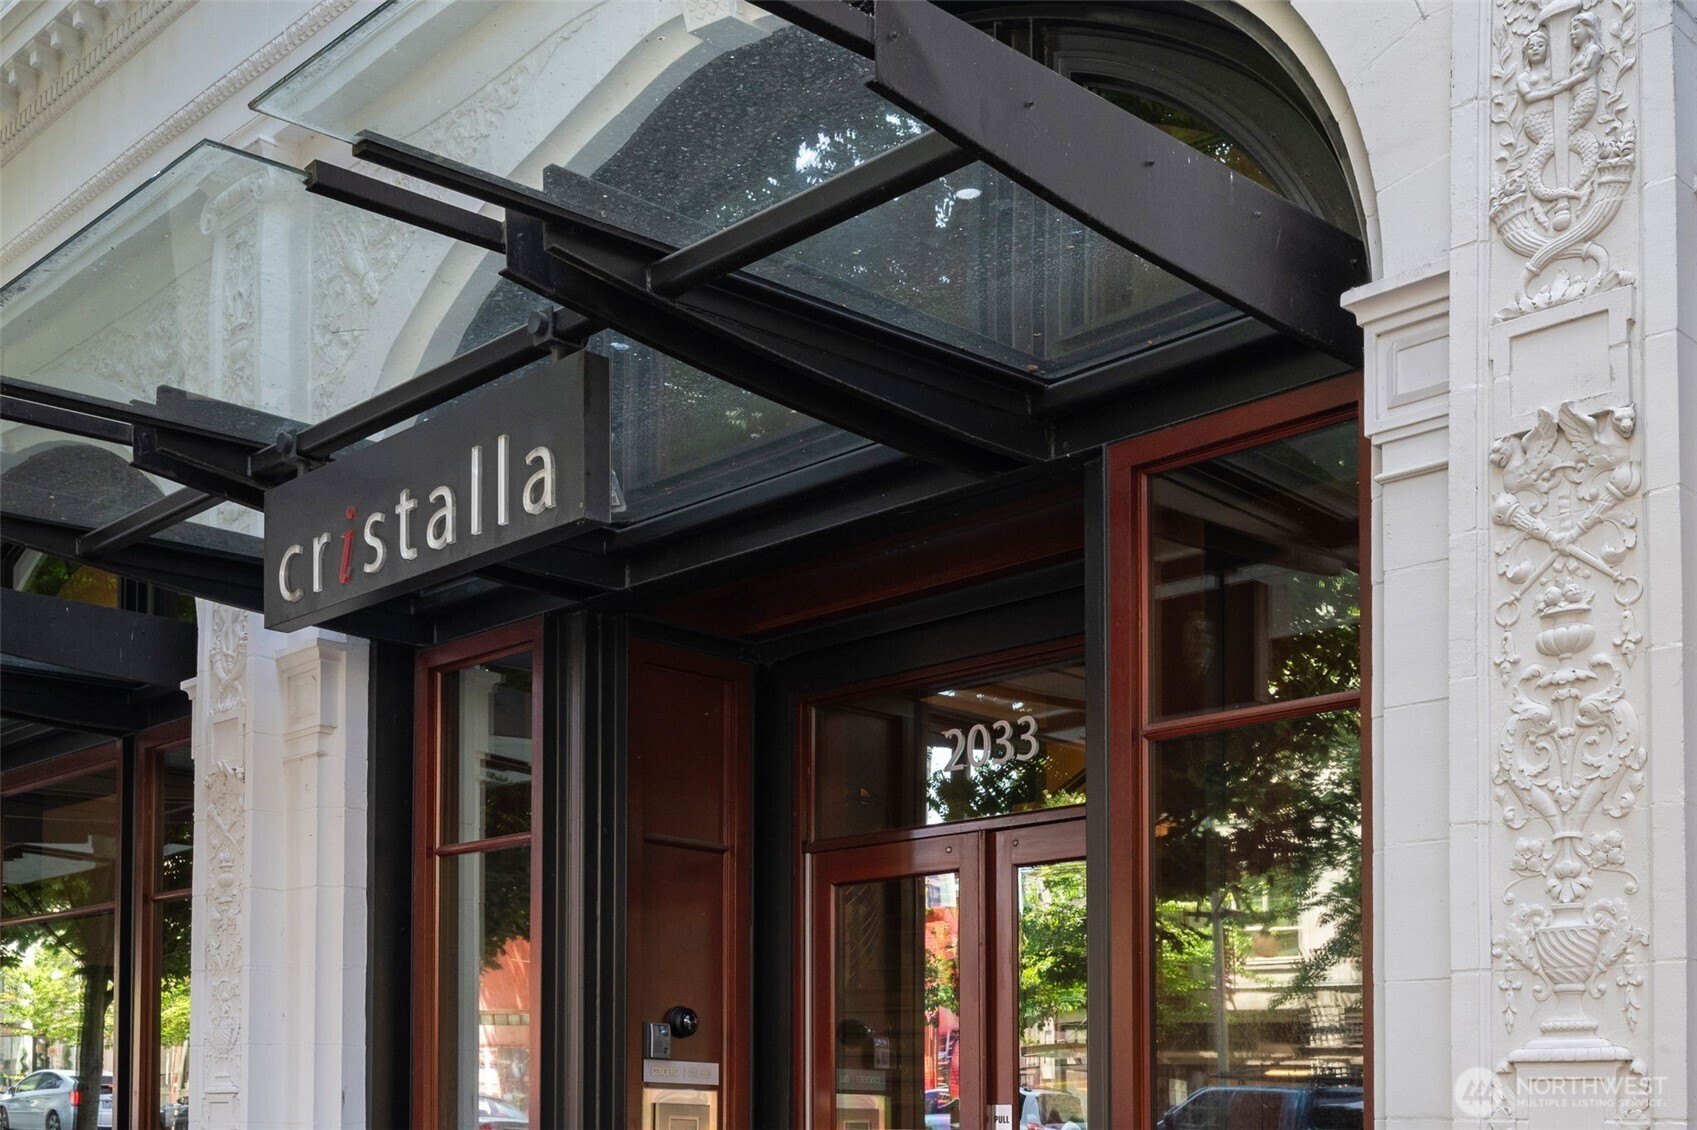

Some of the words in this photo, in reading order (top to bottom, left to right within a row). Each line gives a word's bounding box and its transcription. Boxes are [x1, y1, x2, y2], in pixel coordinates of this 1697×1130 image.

[279, 434, 556, 602] cristalla
[942, 715, 1040, 772] 2033
[994, 1115, 1010, 1124] PULL
